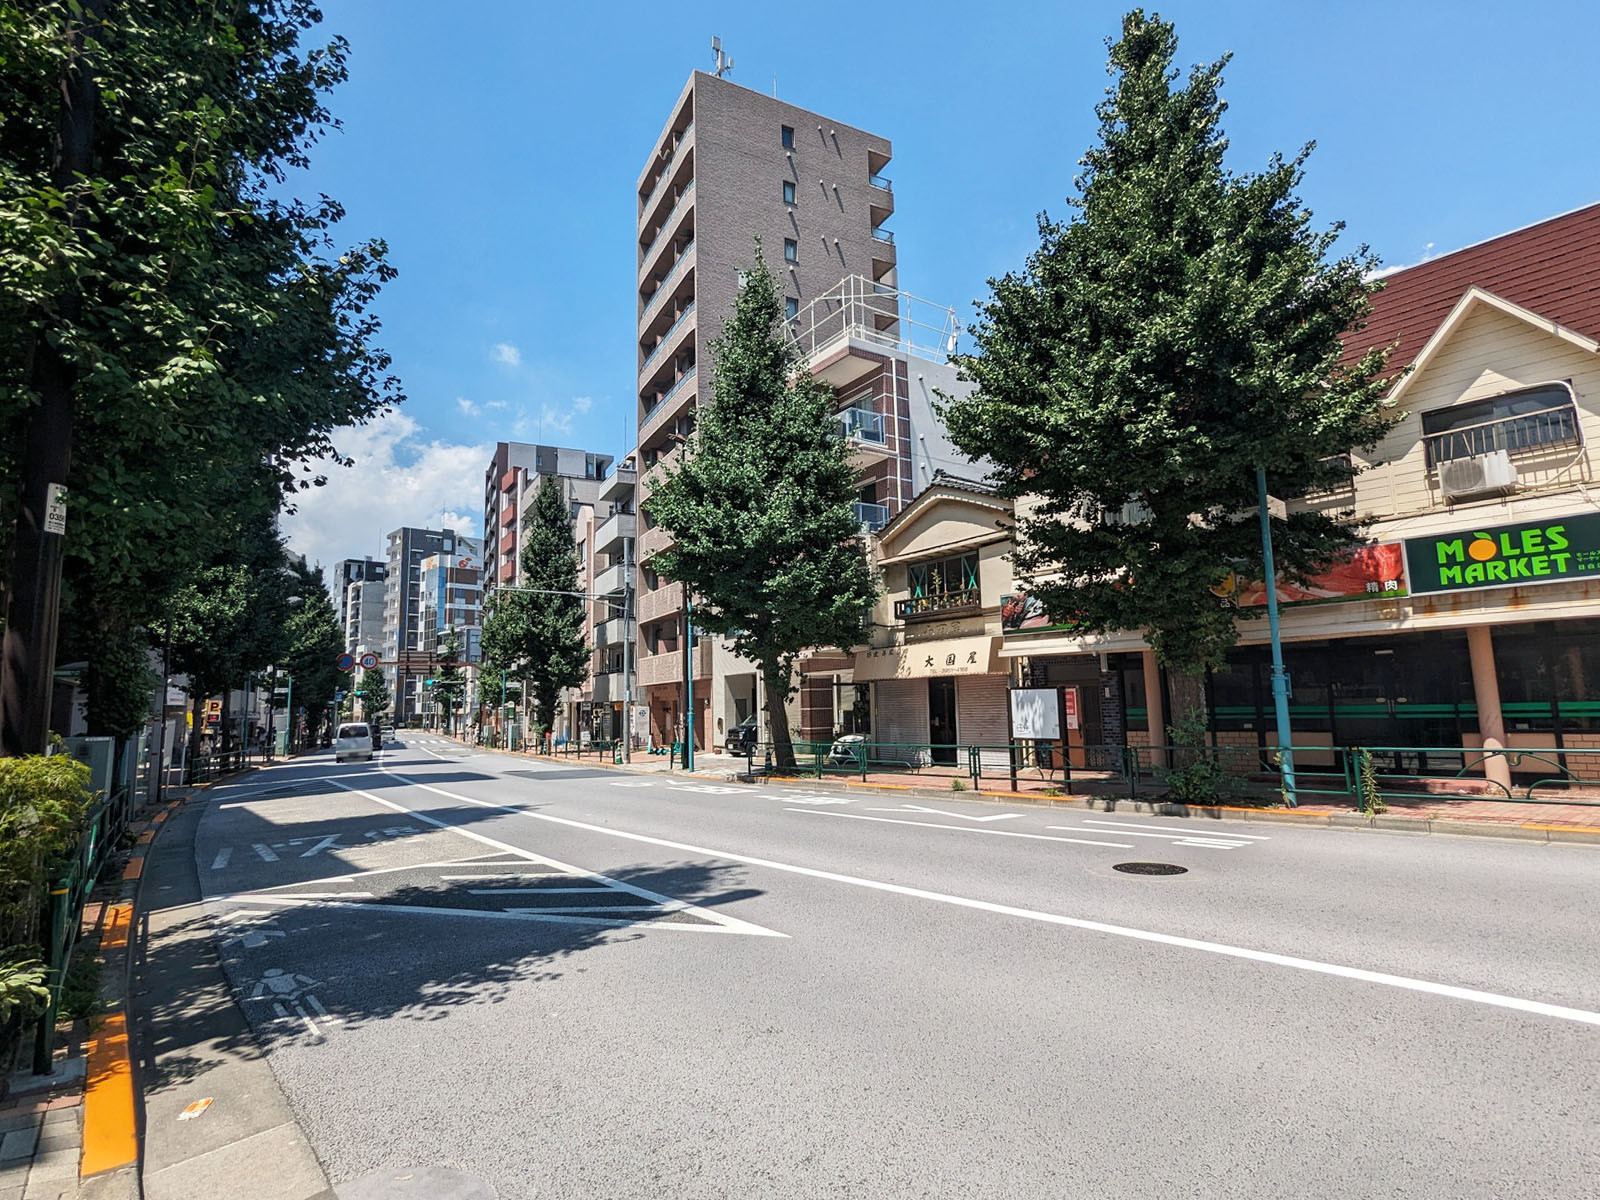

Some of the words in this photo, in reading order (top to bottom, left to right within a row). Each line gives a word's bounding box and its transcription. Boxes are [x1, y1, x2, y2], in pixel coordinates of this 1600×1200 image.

[1435, 525, 1569, 564] MOLES
[1439, 552, 1571, 585] MARKET
[1366, 580, 1398, 592] 精肉
[363, 657, 375, 666] 40
[925, 651, 977, 668] 大国屋
[210, 702, 219, 711] P
